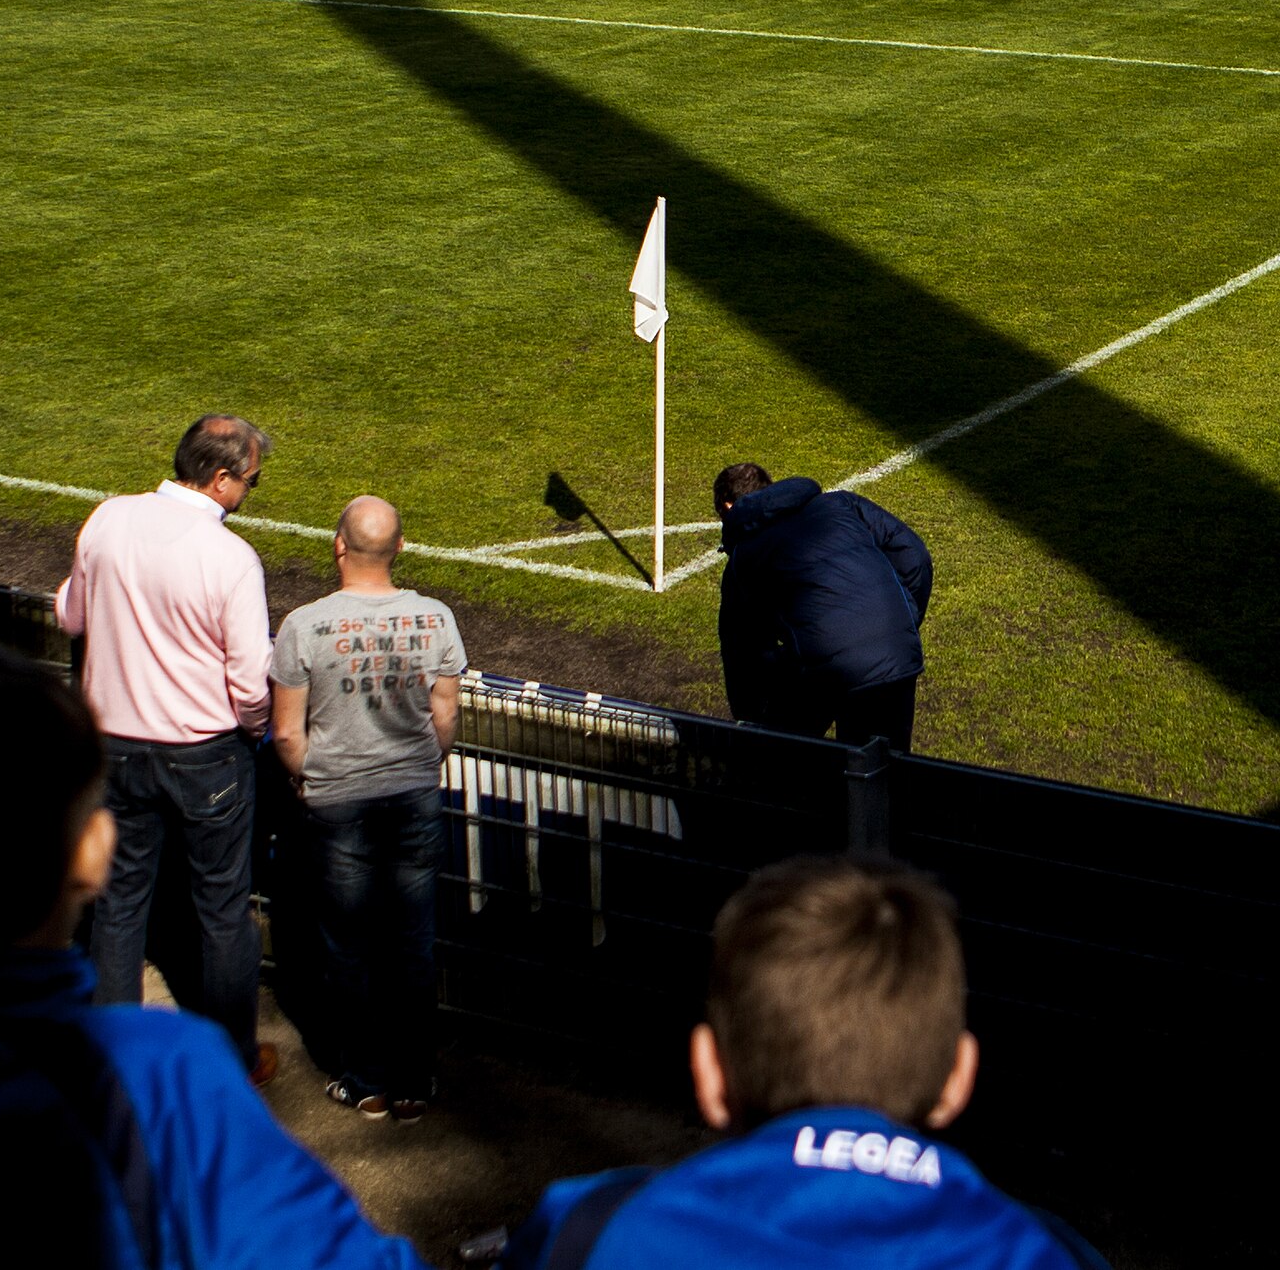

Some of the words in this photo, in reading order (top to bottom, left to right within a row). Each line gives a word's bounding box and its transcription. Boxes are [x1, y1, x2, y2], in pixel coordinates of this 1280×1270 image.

[377, 613, 446, 631] STREET
[335, 634, 432, 655] GARMENT
[793, 1125, 942, 1189] LEGEA
